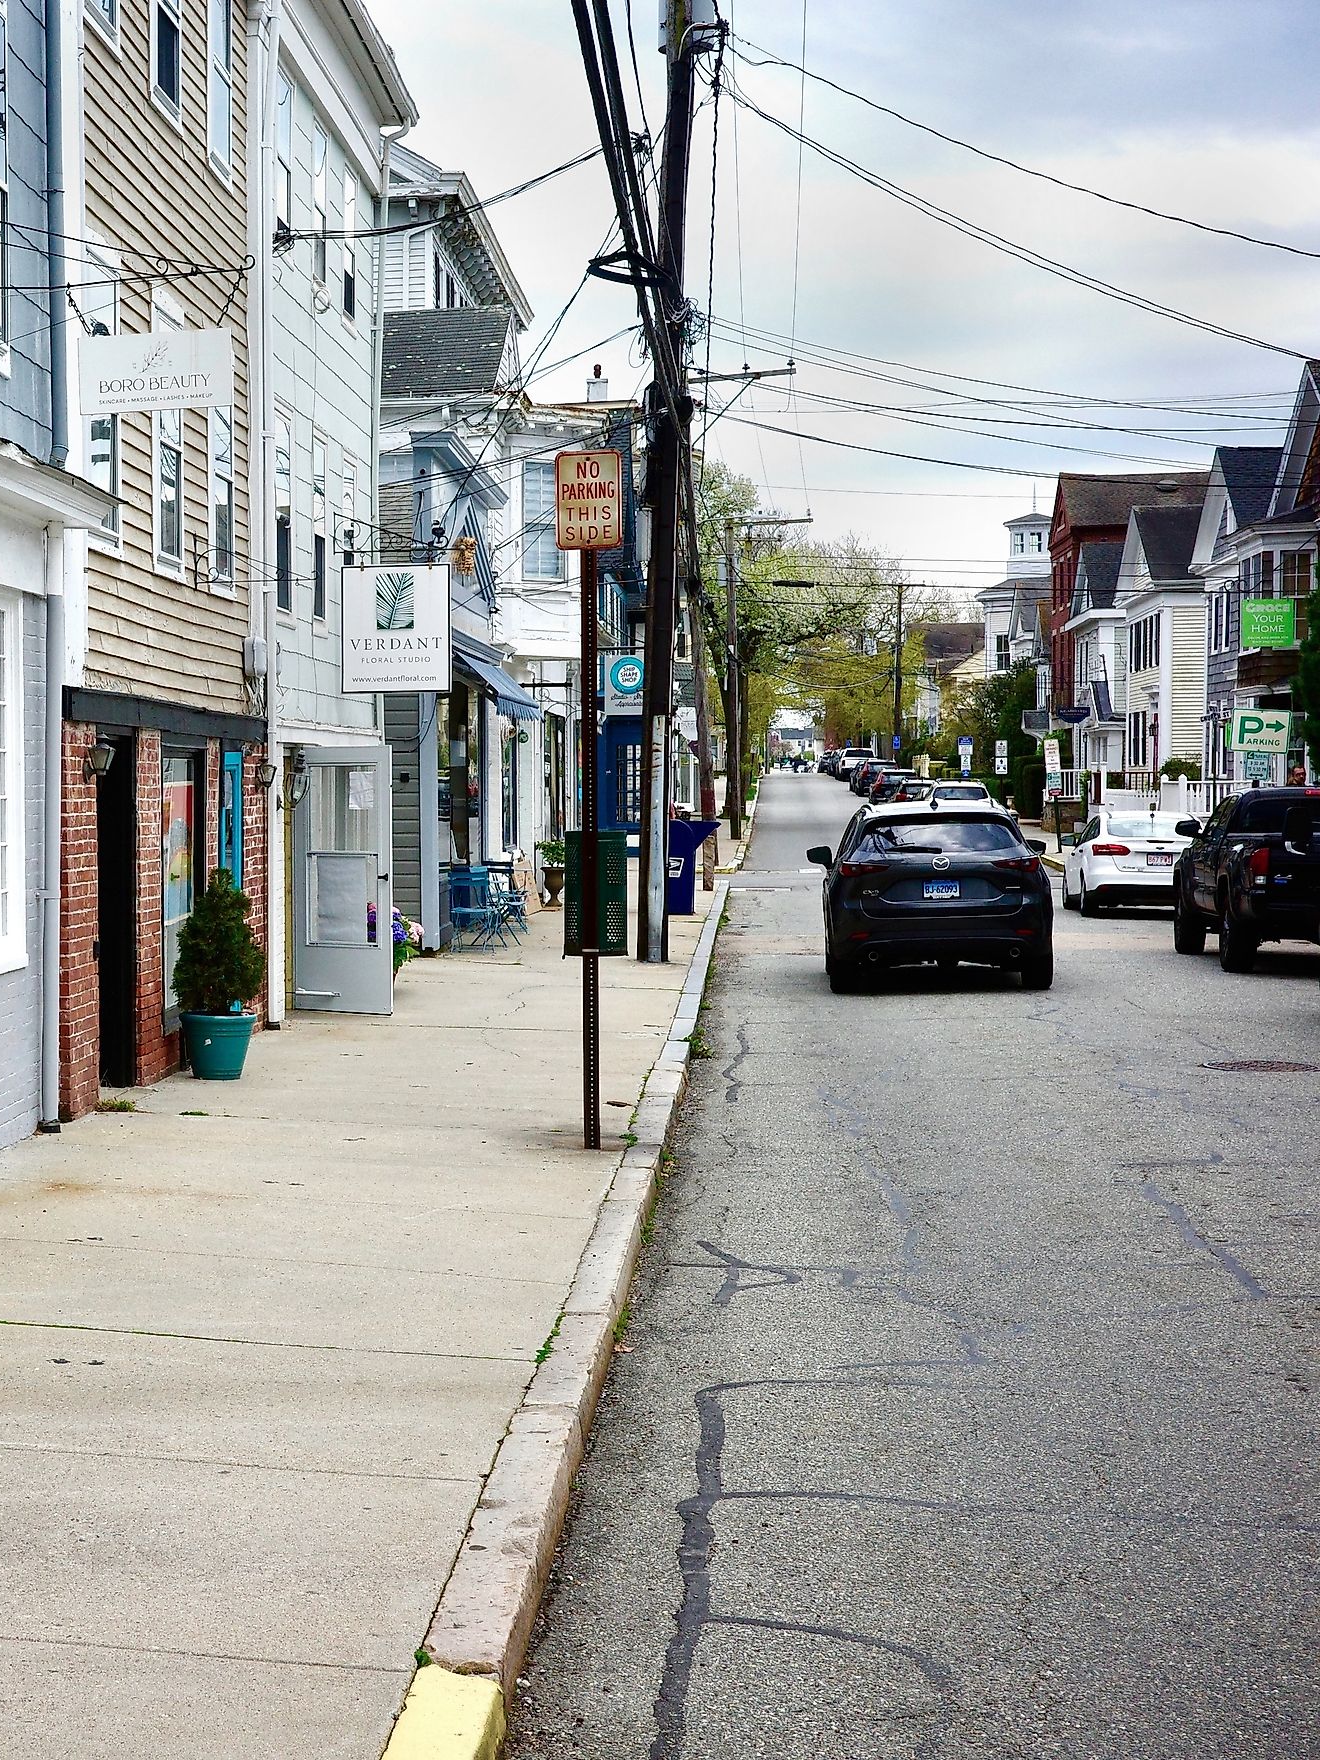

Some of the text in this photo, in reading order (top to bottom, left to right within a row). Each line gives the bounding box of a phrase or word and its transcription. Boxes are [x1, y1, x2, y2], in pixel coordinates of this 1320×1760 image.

[99, 373, 211, 394] BORO BEAUTY
[576, 461, 600, 479] NO
[562, 480, 615, 500] PARKING
[565, 505, 612, 521] THIS
[565, 524, 612, 541] SIDE
[1252, 614, 1284, 623] YOUR
[1251, 624, 1285, 633] HOME
[350, 637, 442, 651] VERDANT
[351, 674, 437, 683] www.verdantfloral.com
